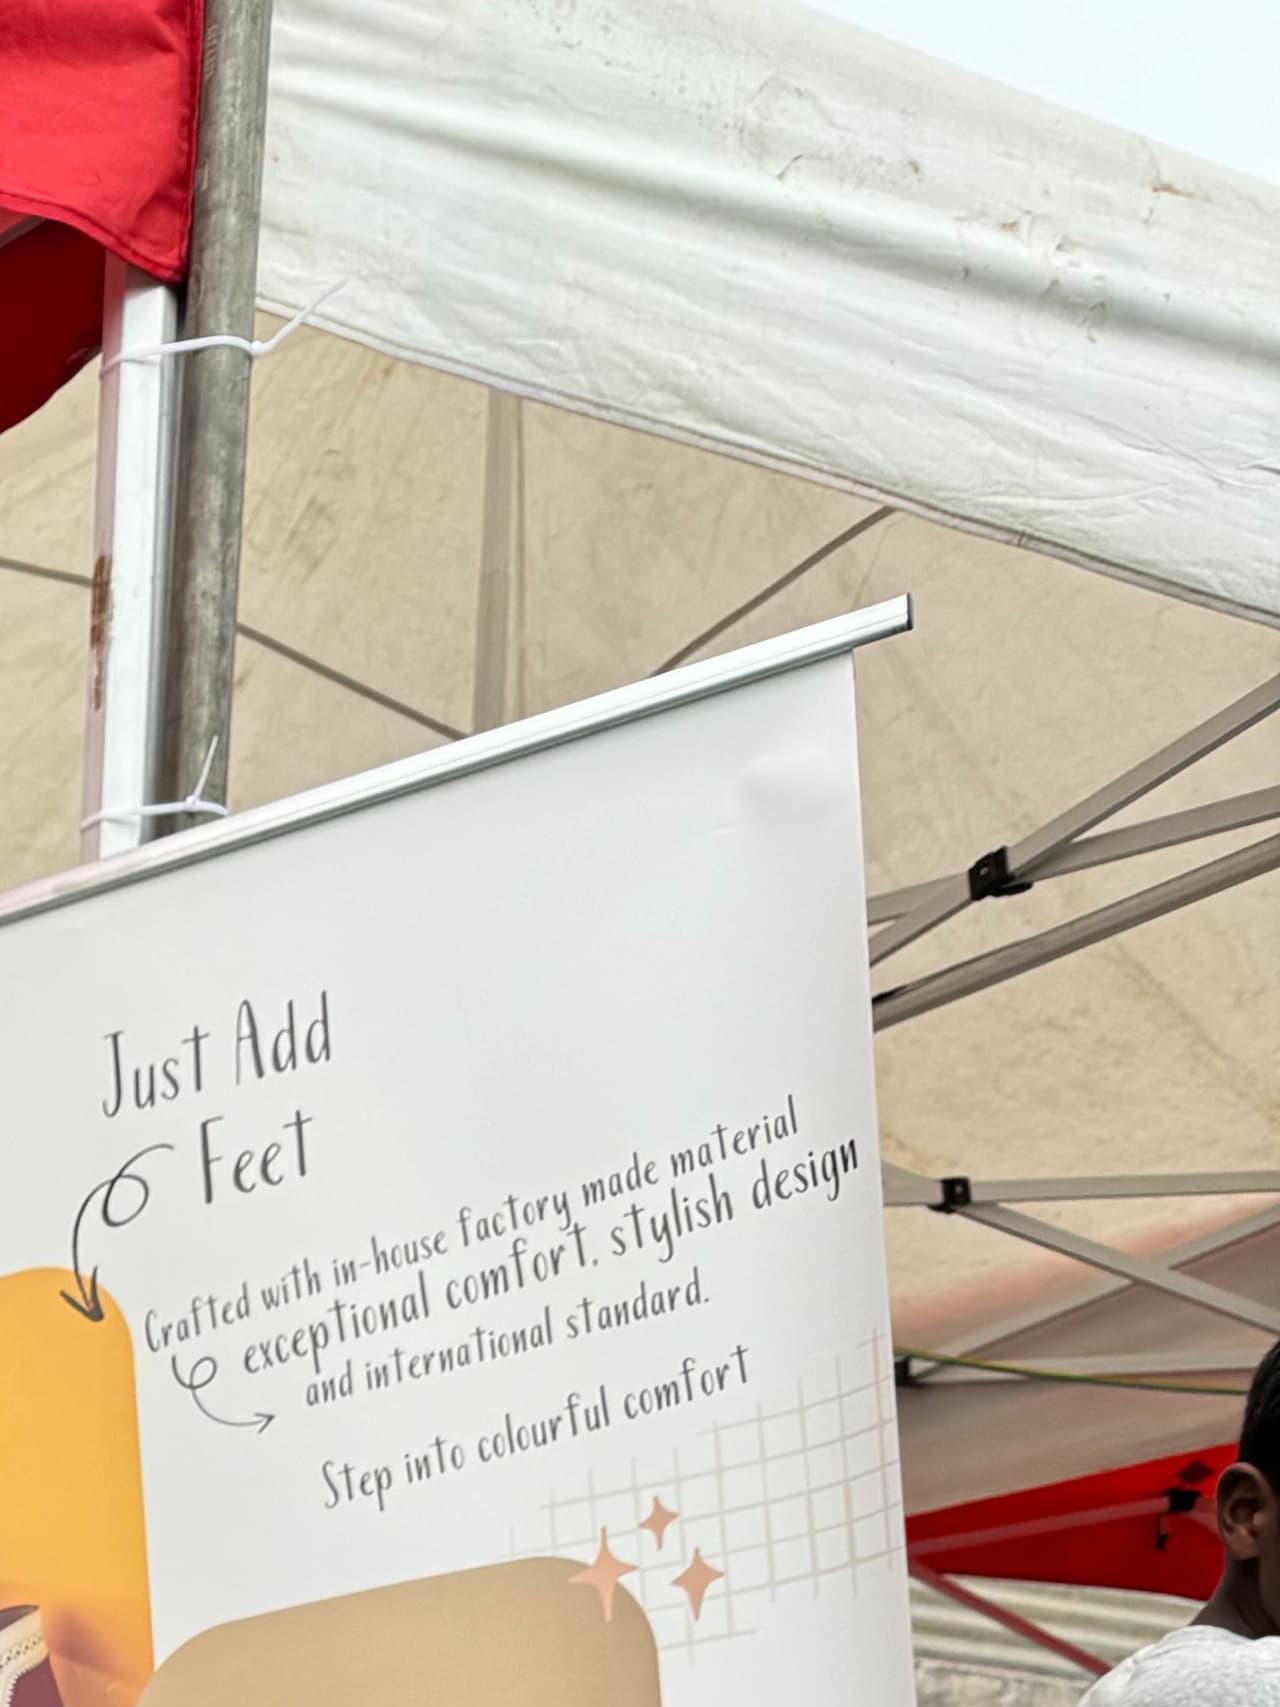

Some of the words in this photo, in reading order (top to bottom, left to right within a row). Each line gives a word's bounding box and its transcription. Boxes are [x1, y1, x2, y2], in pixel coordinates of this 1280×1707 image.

[102, 1025, 211, 1118] Just
[235, 989, 331, 1086] Add
[144, 1281, 251, 1353] Crafted
[260, 1257, 322, 1312] with
[332, 1229, 449, 1288] in-house
[456, 1187, 572, 1247] factory
[581, 1151, 659, 1207] made
[670, 1093, 799, 1178] material
[200, 1109, 313, 1205] Feet
[243, 1269, 430, 1375] exceptional
[610, 1172, 734, 1264] stylish
[752, 1138, 859, 1210] design
[306, 1359, 355, 1407] and
[365, 1305, 554, 1392] international
[565, 1265, 710, 1340] standard.
[321, 1459, 392, 1512] Step
[403, 1434, 466, 1485] into
[478, 1384, 610, 1464] colourful
[623, 1344, 750, 1421] comfort
